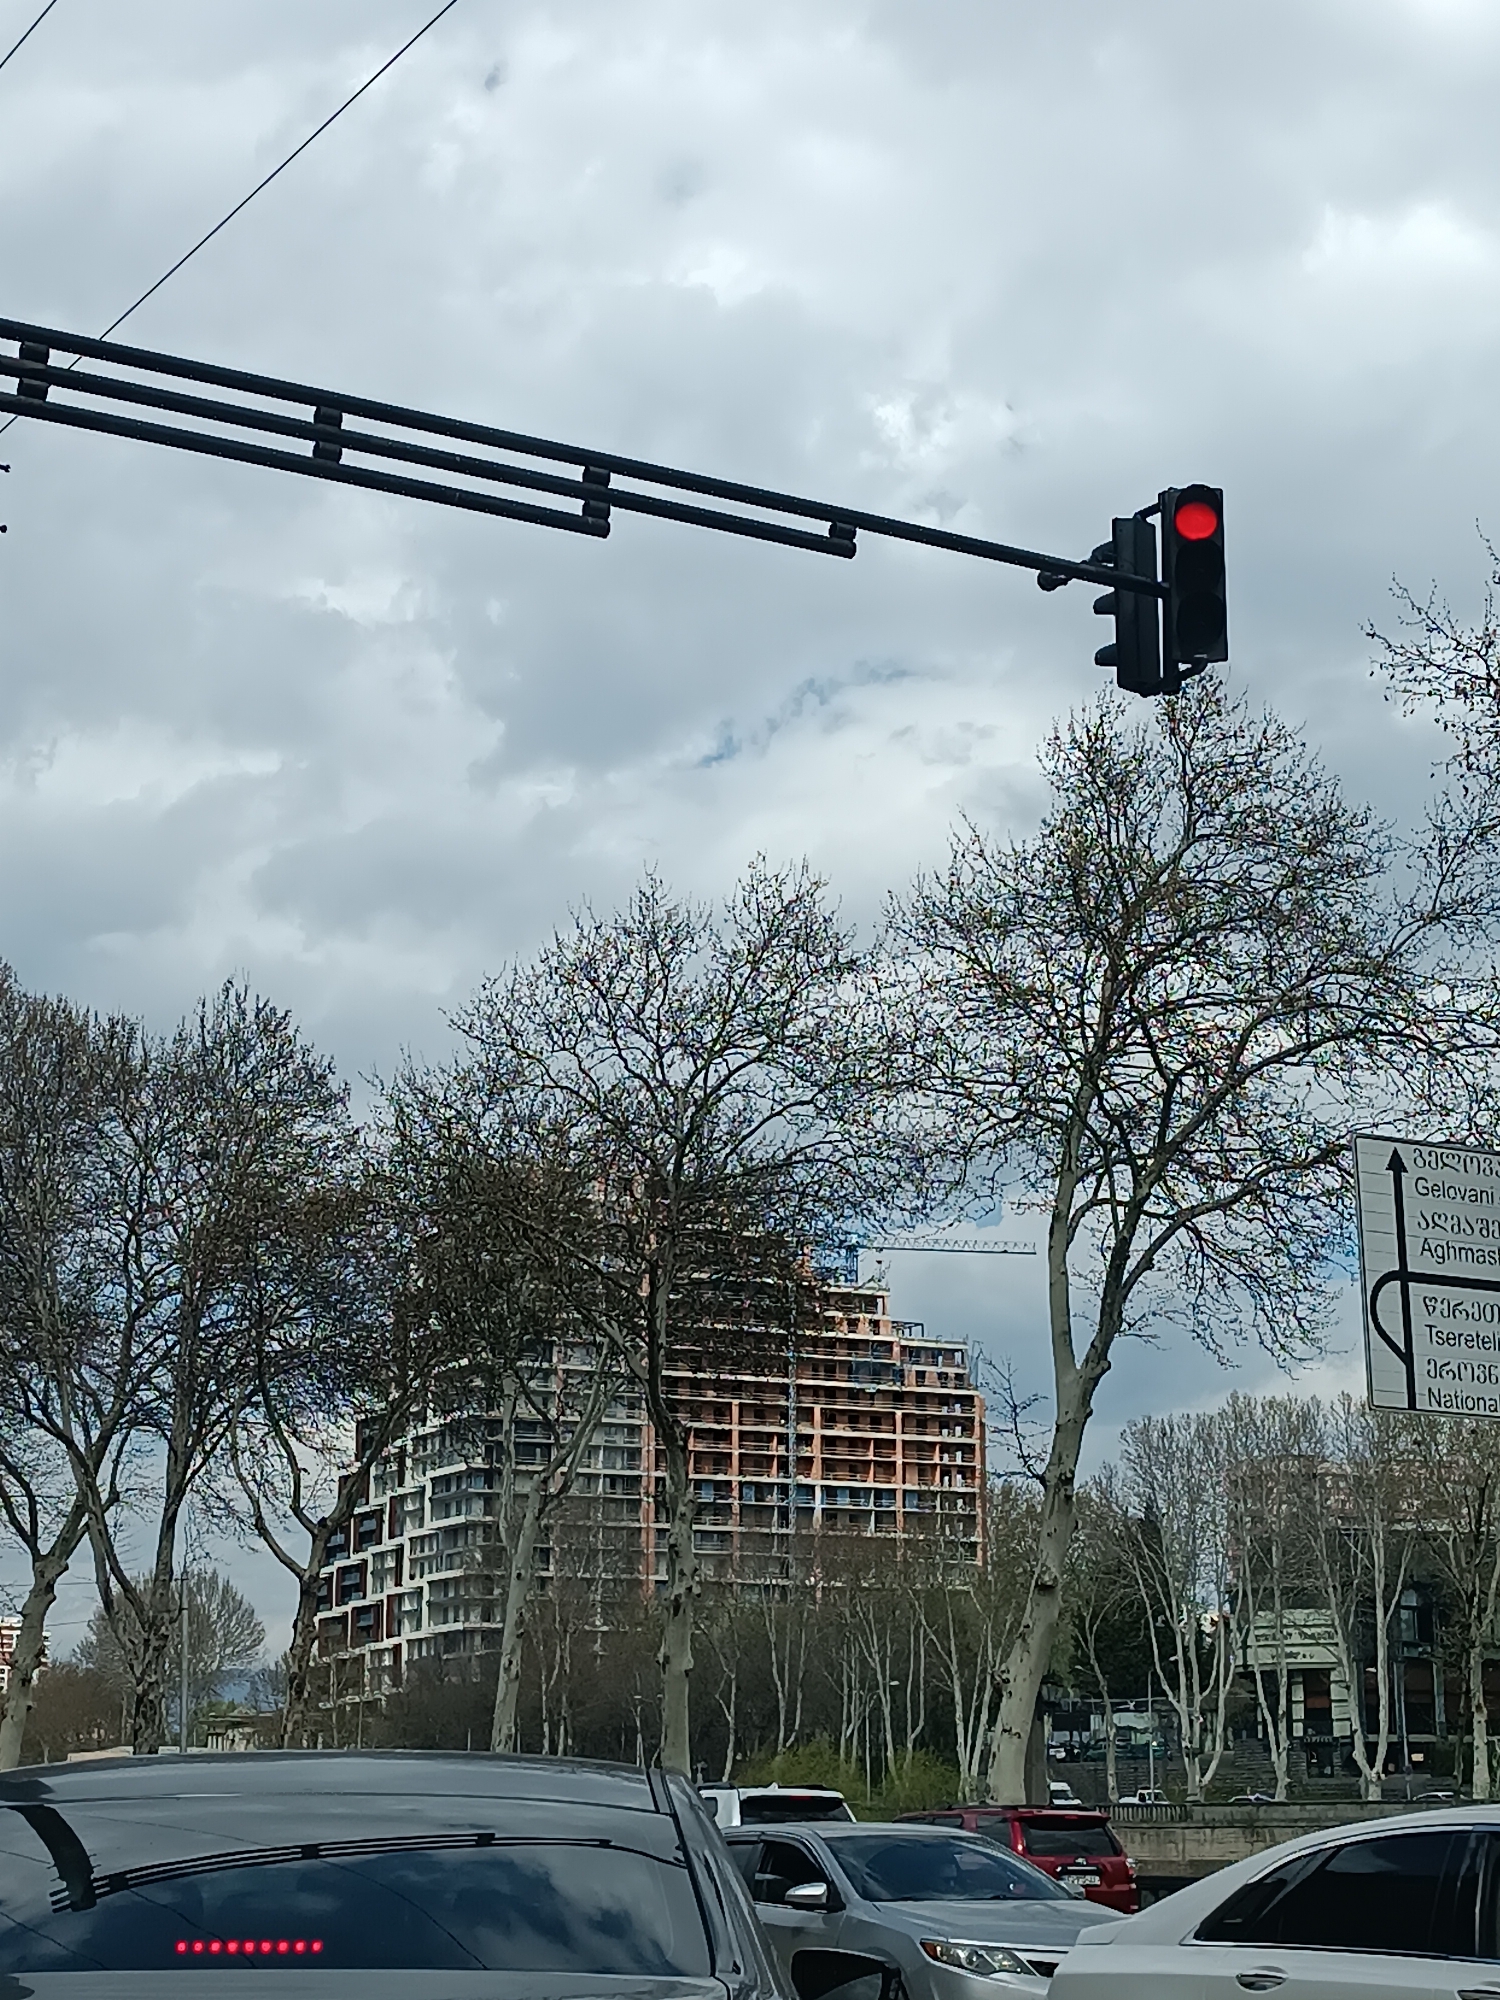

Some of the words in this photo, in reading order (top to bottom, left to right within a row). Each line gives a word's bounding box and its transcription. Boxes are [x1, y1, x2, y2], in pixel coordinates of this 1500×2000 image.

[1415, 1176, 1494, 1205] Gelovani
[1420, 1238, 1500, 1266] Aghmas
[1424, 1324, 1500, 1352] Tsereteli
[1427, 1358, 1499, 1385] ეროვნ
